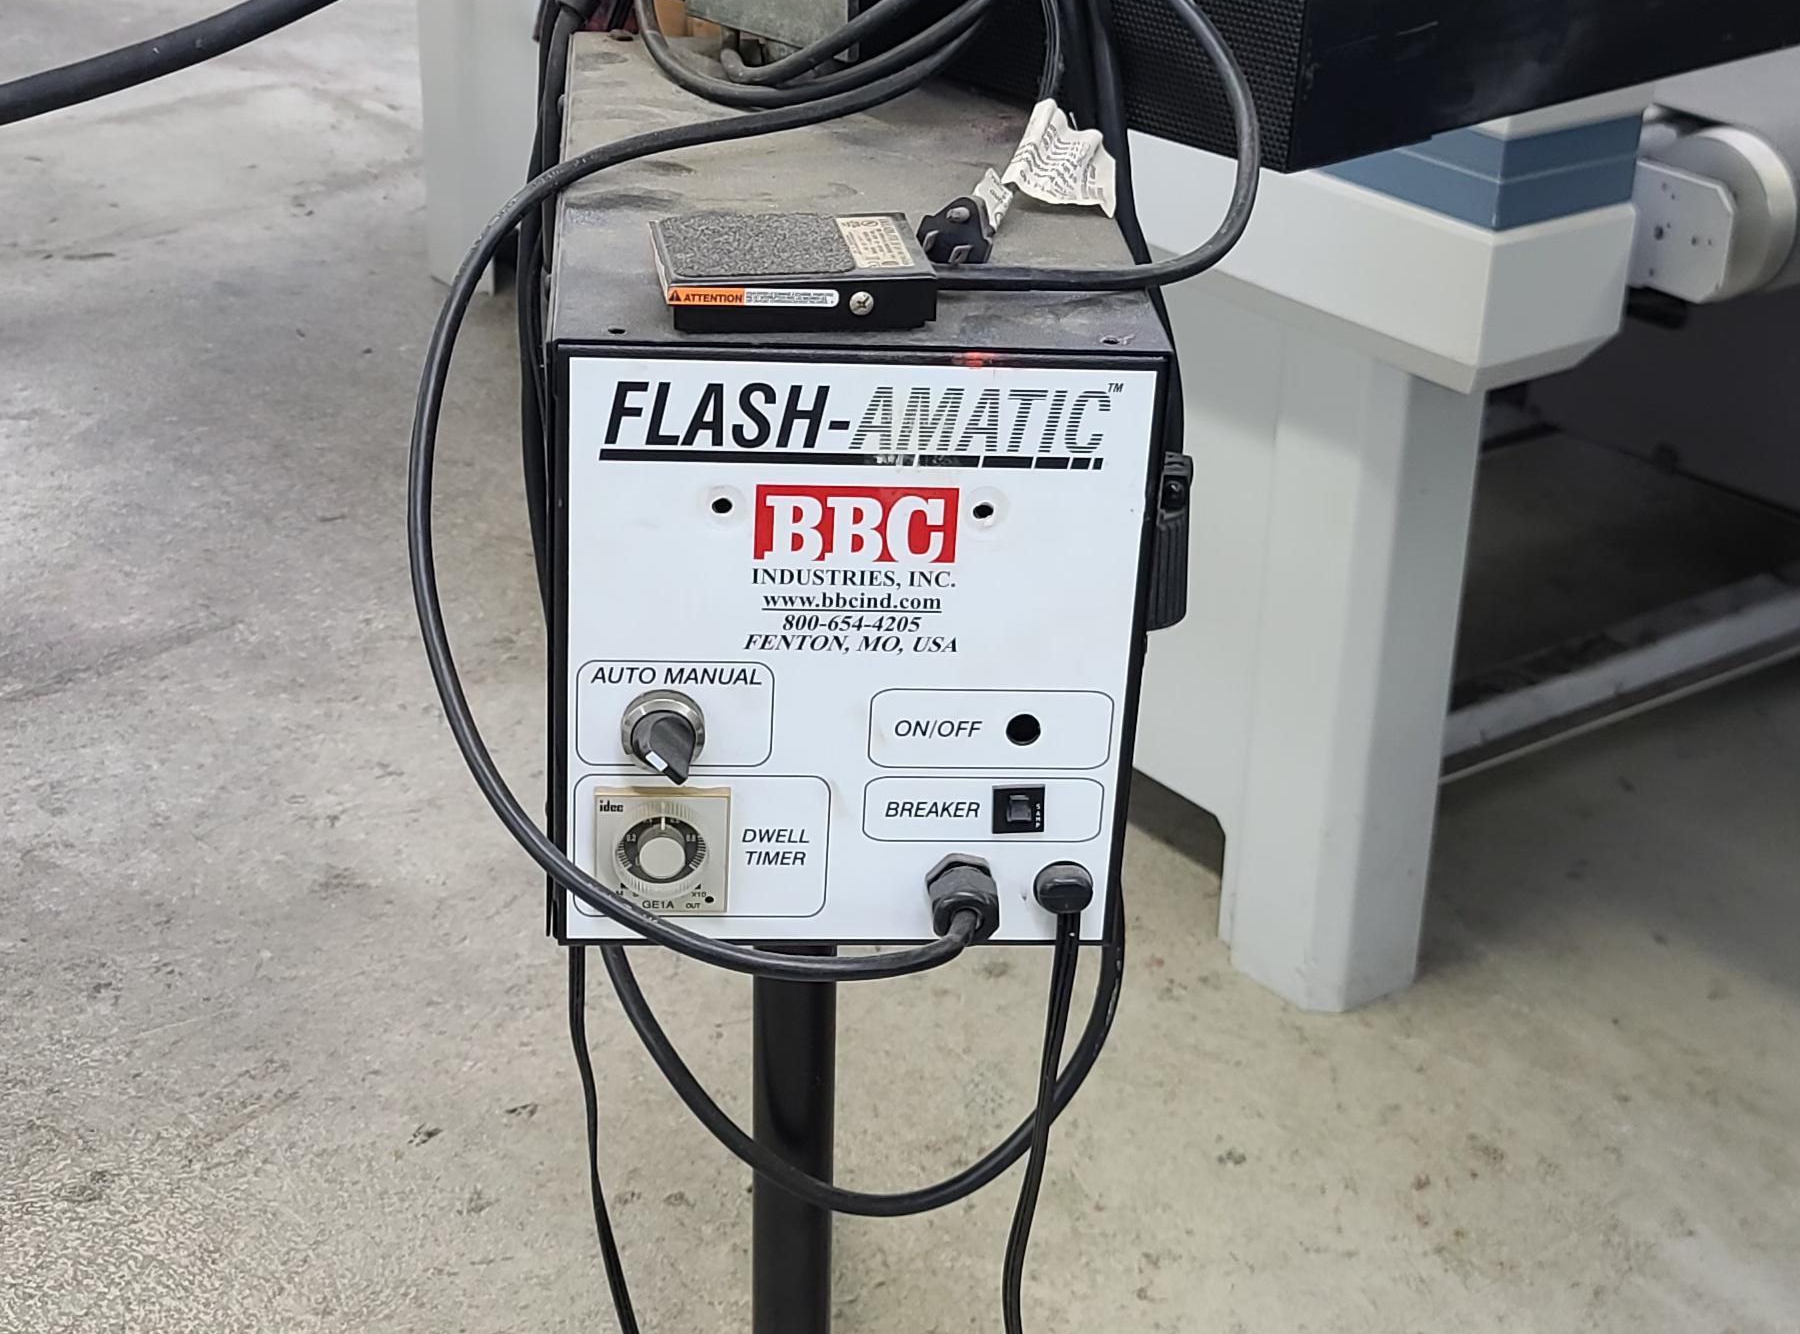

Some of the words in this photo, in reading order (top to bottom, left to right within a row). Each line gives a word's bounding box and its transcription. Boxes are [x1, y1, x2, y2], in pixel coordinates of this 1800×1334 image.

[684, 293, 743, 304] ATTENTION
[604, 380, 1111, 454] FLASH-AMATIC
[764, 495, 946, 564] BBC
[752, 568, 901, 590] INDUSTRIES,
[908, 570, 956, 587] INC.
[762, 592, 942, 610] www.bbcind.com
[782, 614, 922, 633] 800-654-4205
[744, 633, 851, 654] FENTON,
[856, 634, 904, 654] MO,
[908, 635, 958, 653] USA
[591, 666, 657, 685] AUTO
[663, 667, 763, 686] MANUAL
[894, 719, 984, 739] ON/OFF
[884, 801, 981, 818] BREAKER
[741, 828, 810, 844] DWELL
[745, 850, 807, 866] TIMER
[641, 899, 675, 910] GE1A
[685, 901, 702, 910] OUT
